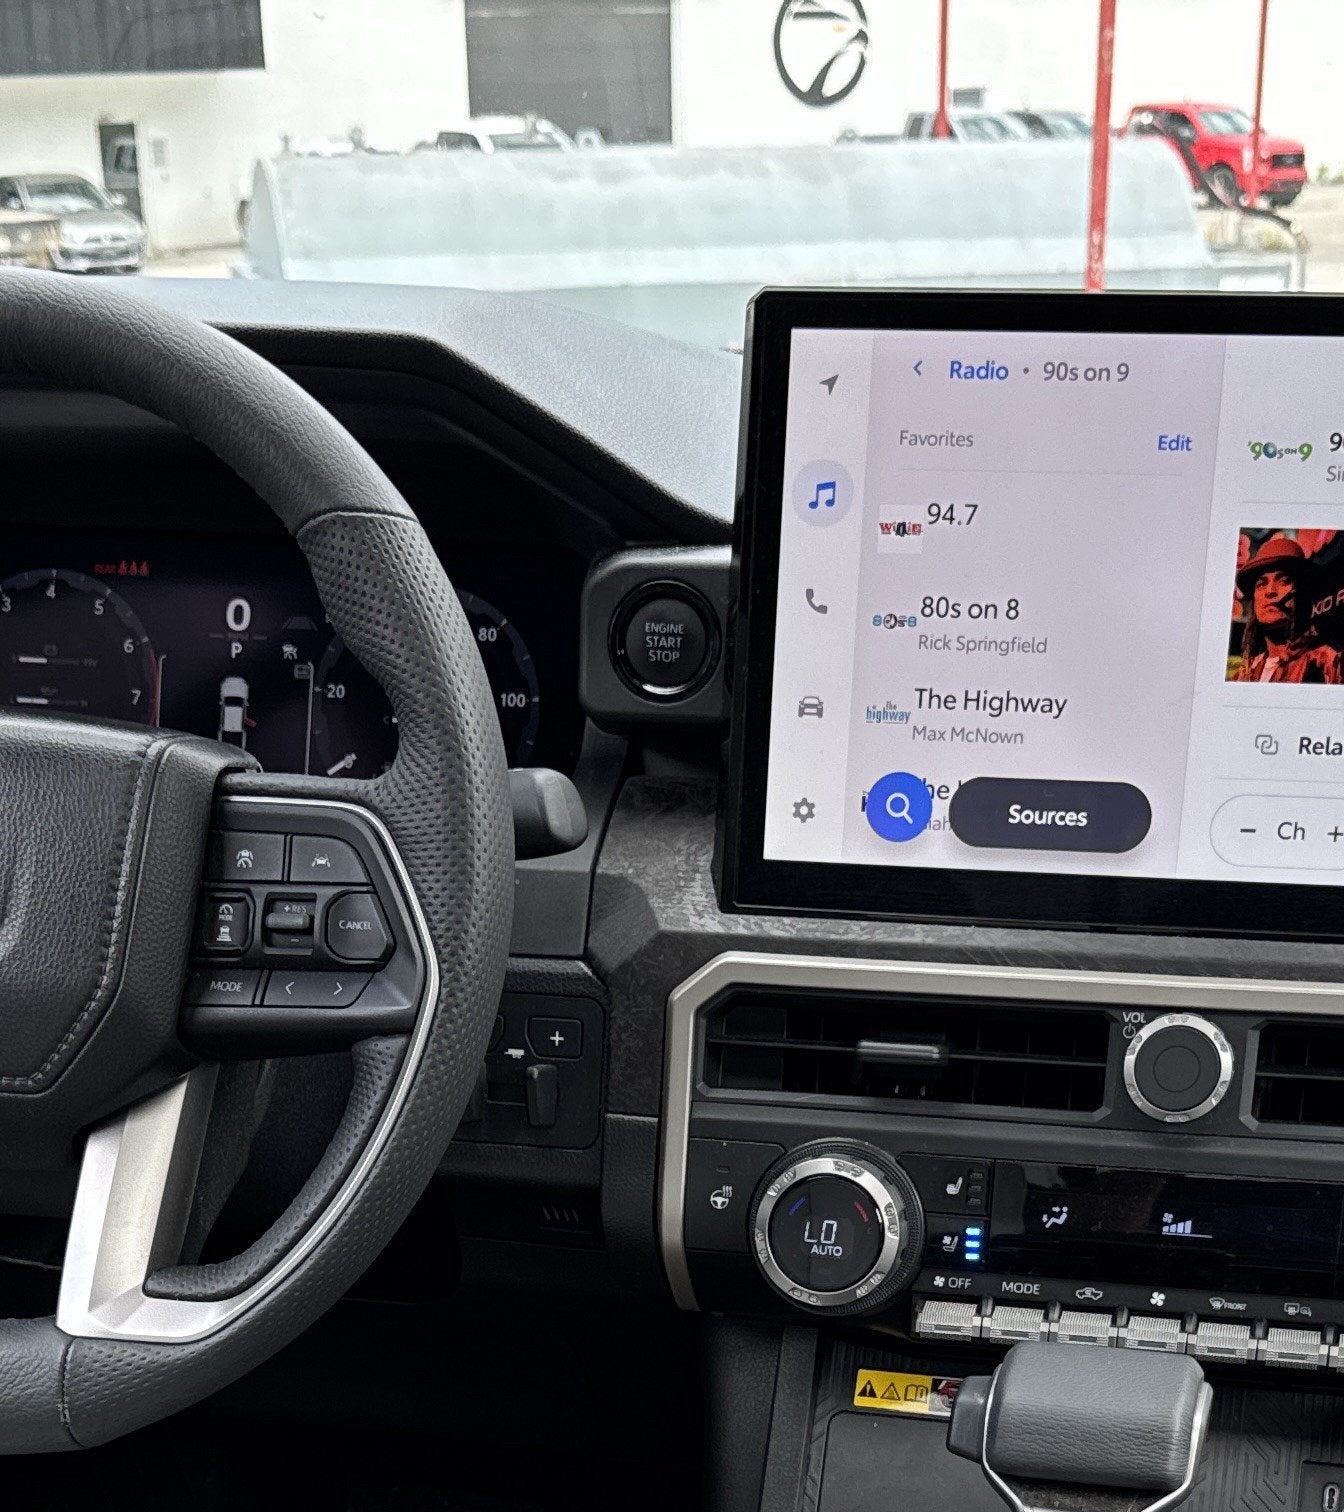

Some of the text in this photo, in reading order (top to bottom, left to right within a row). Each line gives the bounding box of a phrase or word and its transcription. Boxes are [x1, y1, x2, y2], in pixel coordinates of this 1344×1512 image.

[949, 360, 1130, 382] Radio 90s on 9
[899, 429, 974, 448] Favorites
[1158, 434, 1193, 452] Edit
[927, 502, 978, 526] 94.7
[46, 583, 56, 599] 4
[1, 597, 12, 612] 3
[94, 599, 105, 616] 5
[920, 595, 1020, 621] 80s on 8
[226, 597, 252, 632] 0
[478, 627, 498, 642] 80
[645, 621, 685, 635] ENGINE
[123, 638, 134, 654] 6
[645, 635, 683, 649] START
[918, 633, 1048, 657] Rick Springfield
[231, 642, 243, 659] P
[648, 650, 681, 663] STOP
[131, 688, 142, 705] 7
[327, 683, 346, 699] 20
[500, 693, 527, 708] 100
[914, 688, 1068, 719] The Highway
[865, 704, 912, 725] highway
[912, 726, 1024, 745] Max McNown
[1008, 803, 1088, 828] Sources
[1276, 821, 1306, 841] Ch
[339, 919, 372, 931] CANCEL
[209, 980, 243, 993] MODE
[1122, 1011, 1147, 1024] VOL
[804, 1219, 838, 1244] LO
[810, 1244, 843, 1257] AUTO
[948, 1277, 973, 1289] OFF
[1001, 1281, 1041, 1295] MODE
[1224, 1302, 1247, 1312] FRONT
